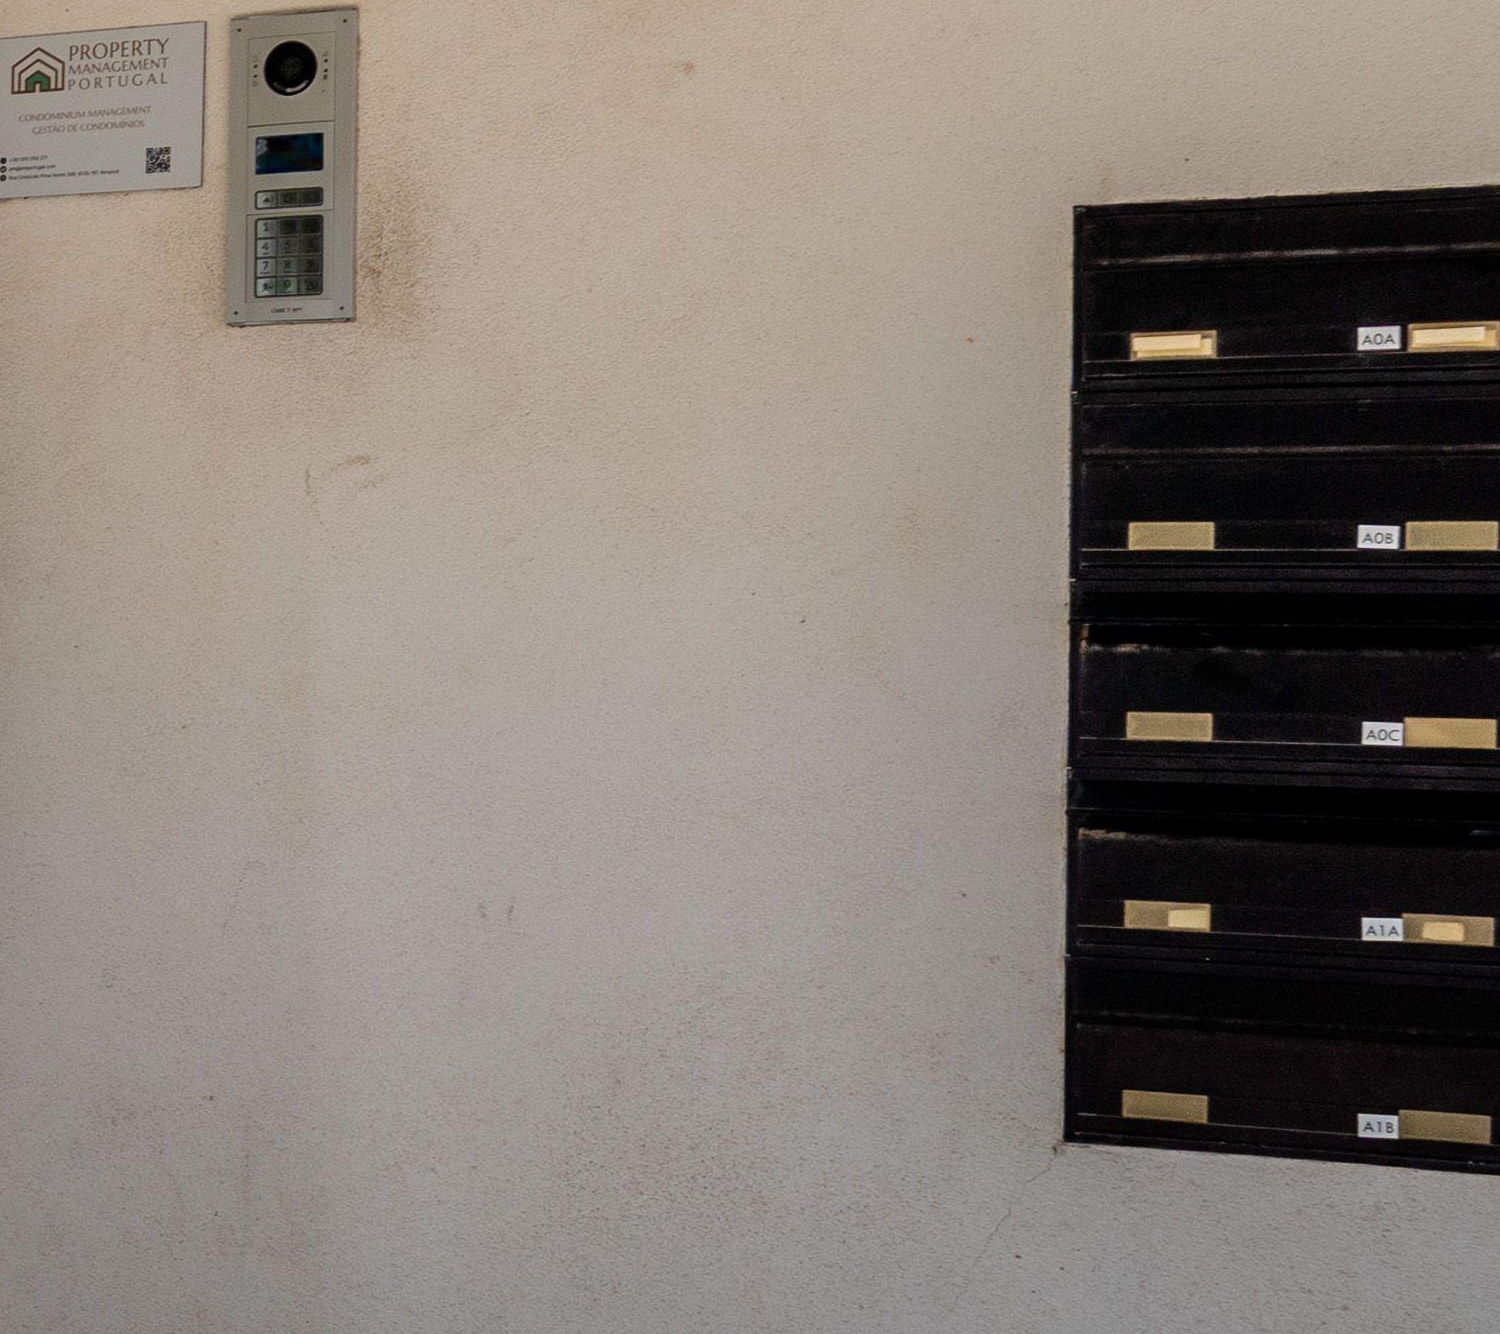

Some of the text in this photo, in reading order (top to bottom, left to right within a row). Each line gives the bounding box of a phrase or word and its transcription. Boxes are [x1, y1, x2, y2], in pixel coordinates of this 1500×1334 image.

[69, 38, 170, 61] PROPERTY
[68, 57, 169, 75] MANAGEMENT
[68, 72, 168, 91] PORTUGAL
[88, 105, 152, 118] MANAGEMENT
[262, 261, 269, 270] 7
[1365, 924, 1400, 936] A1A
[1363, 1121, 1394, 1133] A1B
